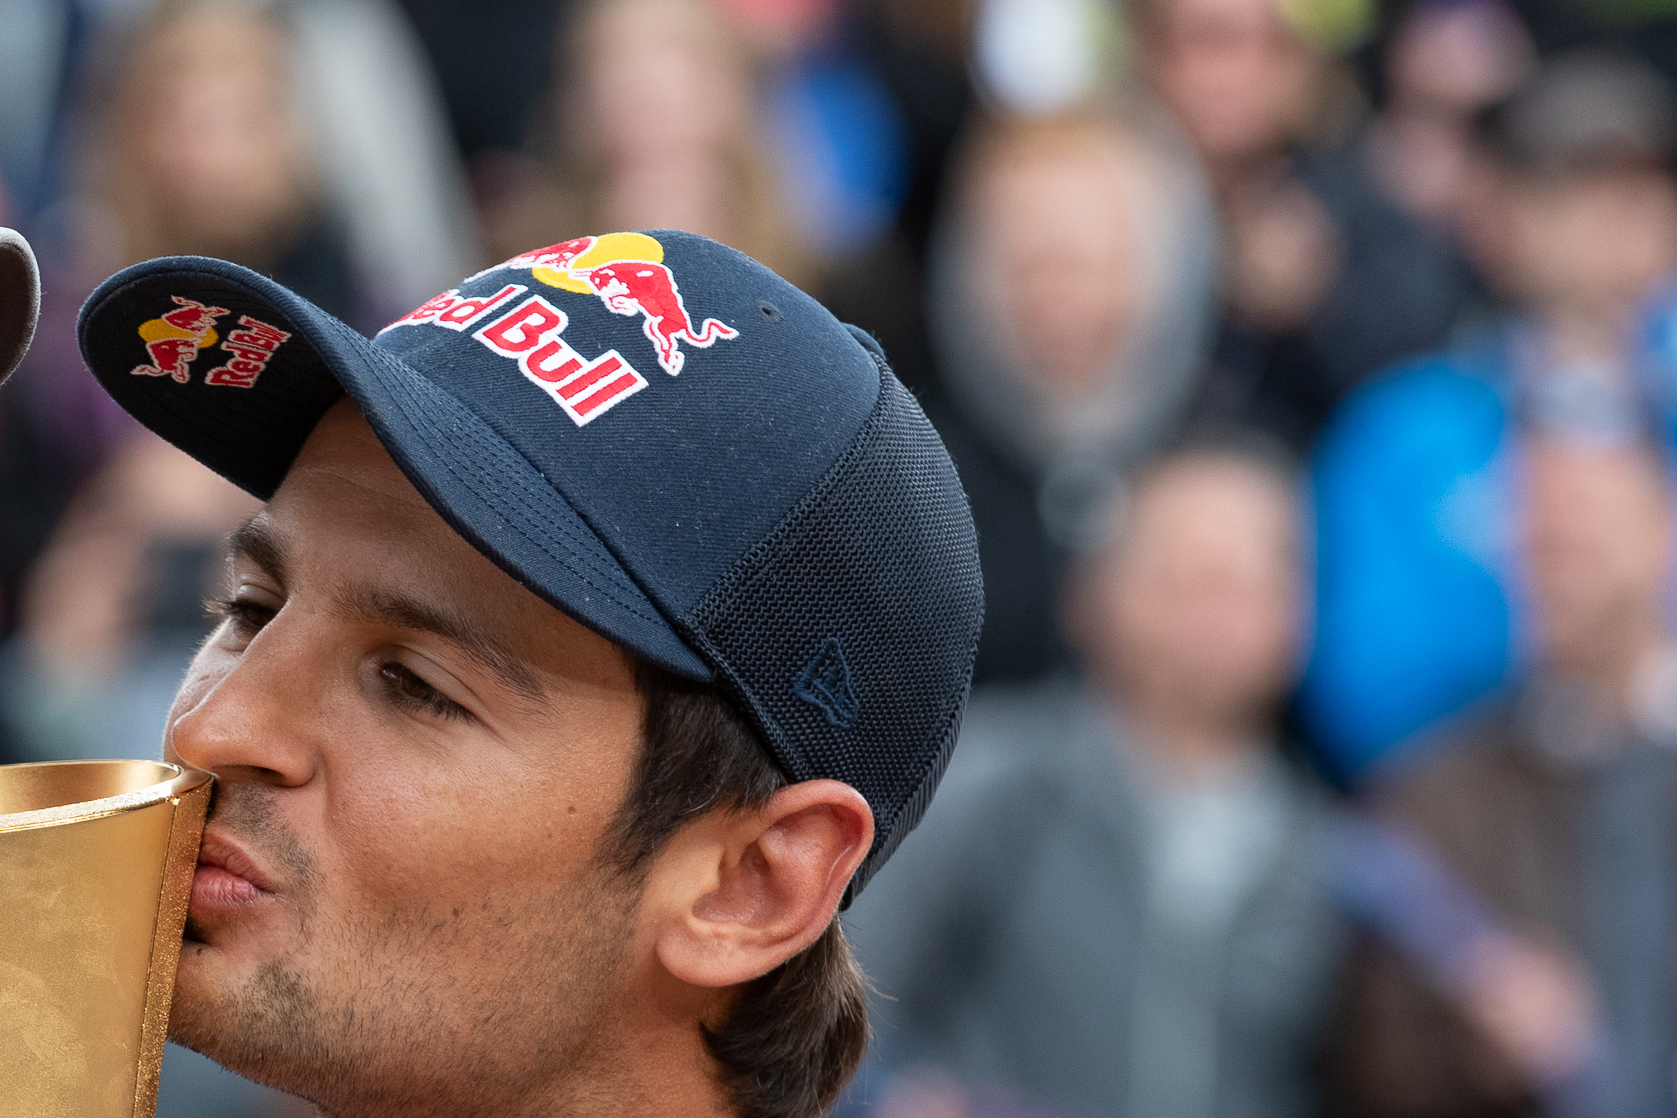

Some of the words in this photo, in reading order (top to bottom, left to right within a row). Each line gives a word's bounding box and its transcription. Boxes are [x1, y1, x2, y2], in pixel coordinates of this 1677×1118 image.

[231, 318, 288, 351] Bull
[208, 343, 268, 388] Red
[482, 300, 638, 417] Bull
